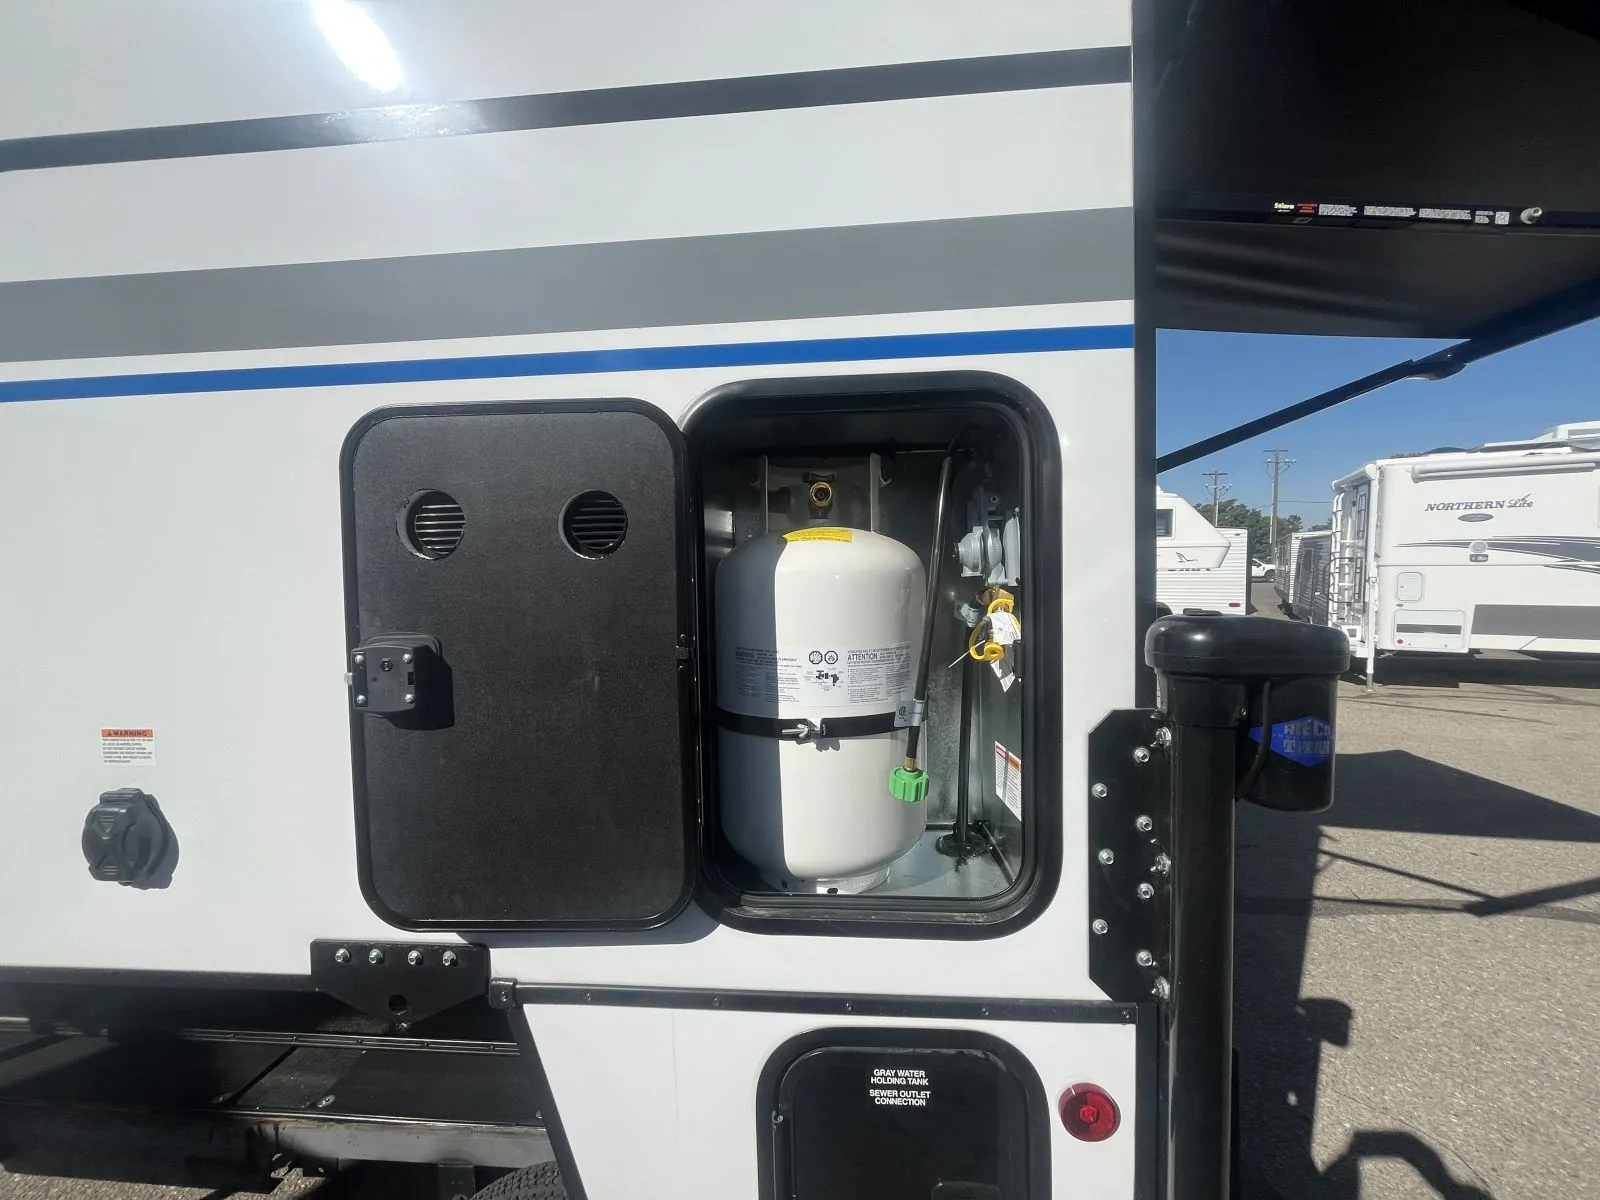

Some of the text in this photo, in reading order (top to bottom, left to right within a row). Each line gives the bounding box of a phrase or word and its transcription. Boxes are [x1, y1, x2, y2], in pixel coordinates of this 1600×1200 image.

[1424, 500, 1506, 512] NORTHERN
[847, 652, 878, 661] ATTENTION
[873, 1068, 926, 1078] GRAY WATER
[870, 1076, 929, 1086] HOLDING TANK
[869, 1089, 931, 1099] SEWER OUTLET
[874, 1097, 926, 1106] CONNECTION
